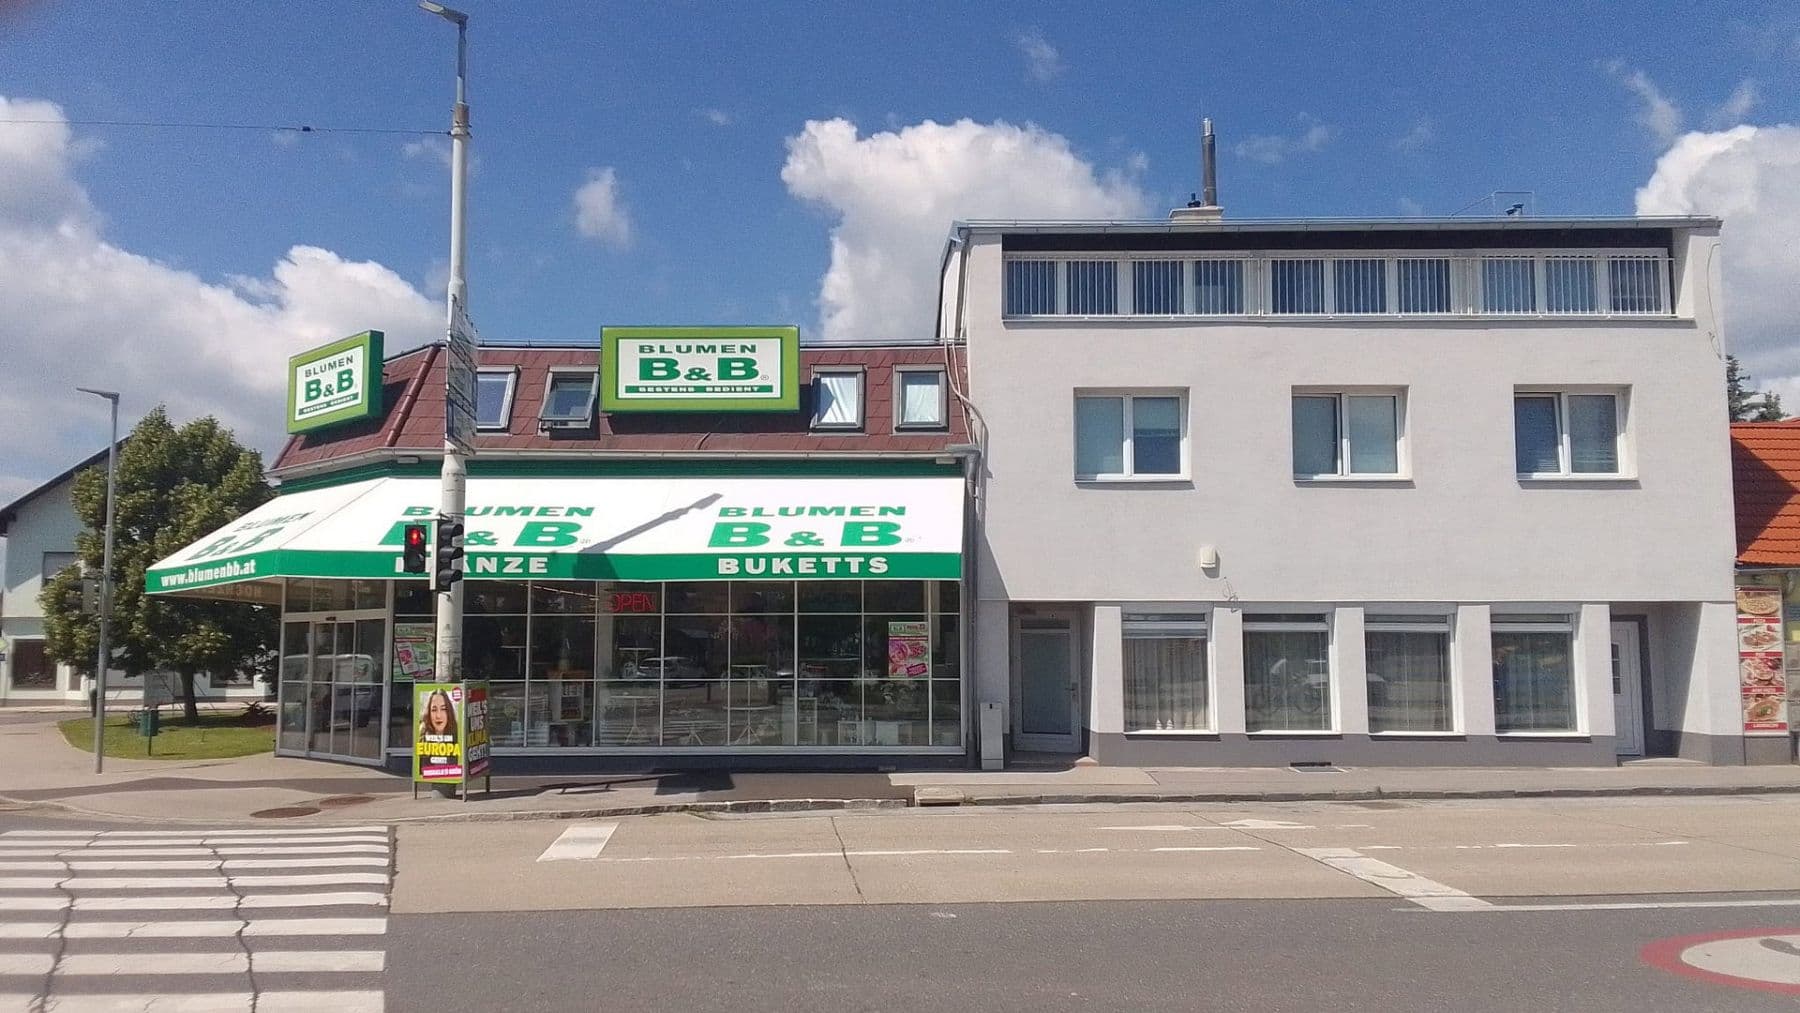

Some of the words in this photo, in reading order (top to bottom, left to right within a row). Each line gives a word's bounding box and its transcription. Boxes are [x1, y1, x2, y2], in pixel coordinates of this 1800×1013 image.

[639, 344, 756, 354] BLUMEN
[305, 355, 354, 378] BLUMEN
[639, 357, 760, 381] B&B
[305, 368, 354, 402] B&B
[402, 506, 595, 517] BUMEN
[718, 506, 906, 517] BLUMEN
[186, 526, 285, 560] B&B
[707, 521, 902, 547] B&B
[162, 560, 257, 587] www.blumenbb.at
[395, 557, 548, 573] NZE
[718, 557, 889, 575] BUKETTS
[608, 593, 656, 612] OPEN
[416, 742, 461, 756] EUROPA
